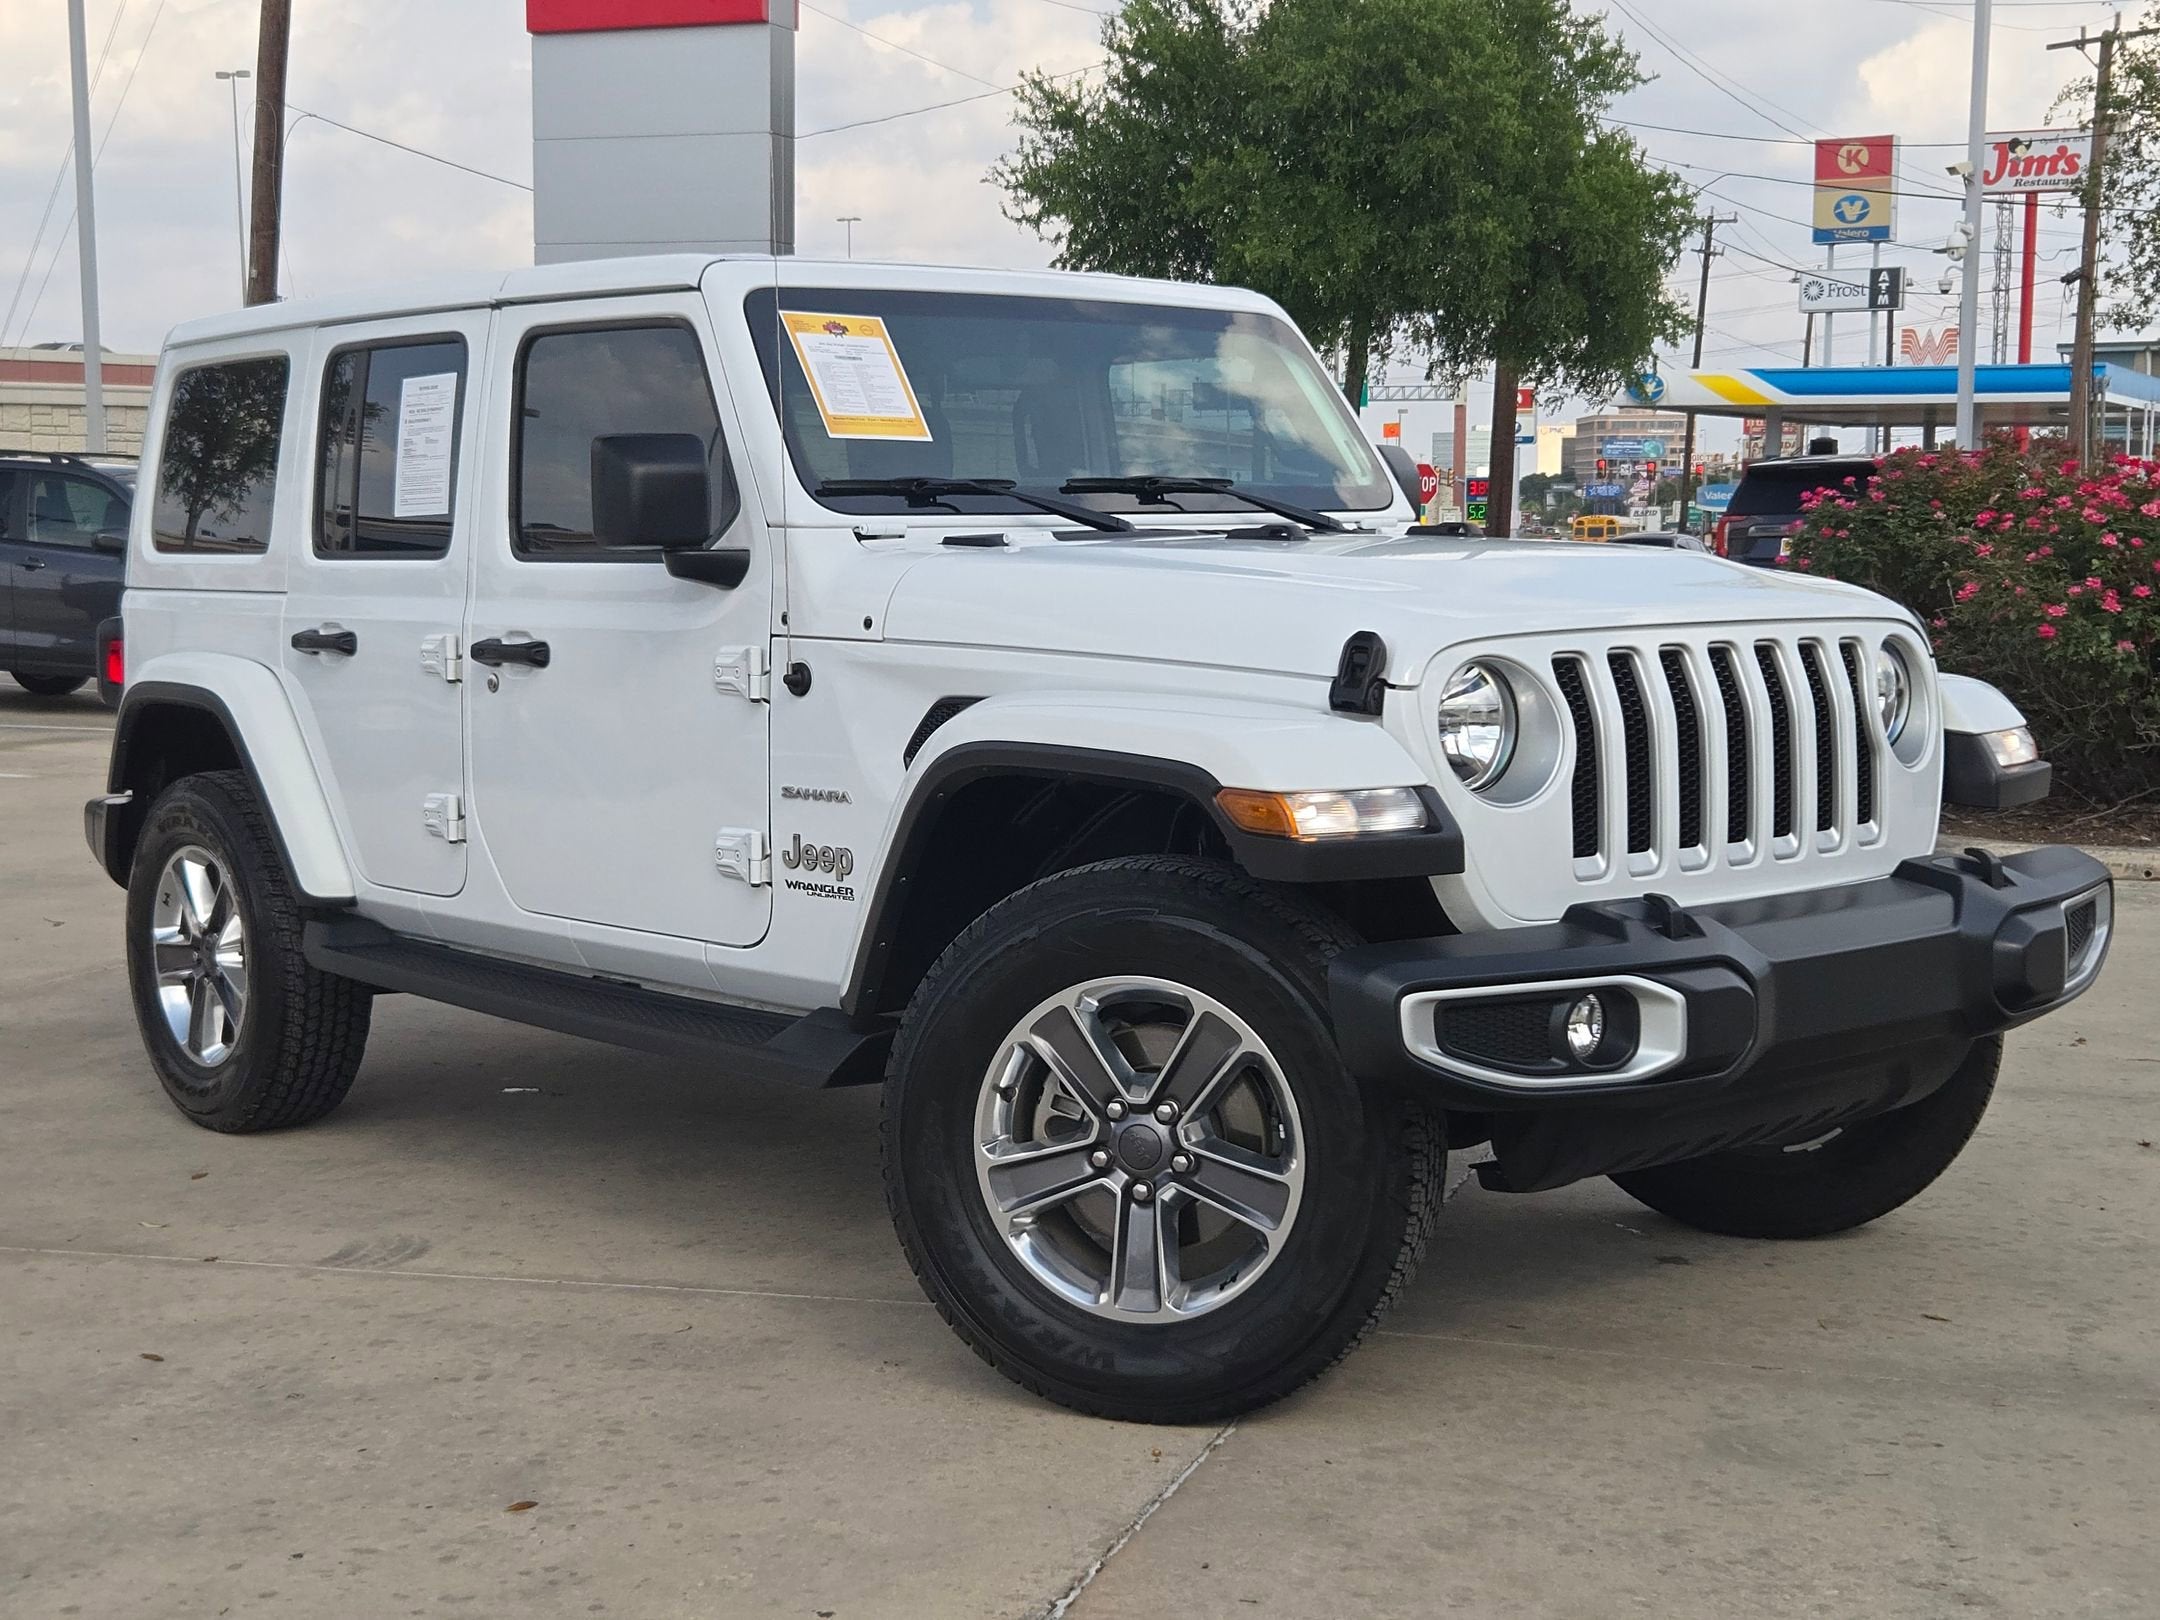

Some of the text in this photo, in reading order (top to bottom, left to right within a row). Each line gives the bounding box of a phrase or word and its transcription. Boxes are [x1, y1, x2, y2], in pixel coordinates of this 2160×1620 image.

[1983, 142, 2081, 186] Jim's
[1833, 228, 1869, 239] Valero
[1826, 283, 1867, 298] Frost
[1877, 270, 1889, 306] ATM
[1420, 477, 1437, 492] OP
[1704, 491, 1734, 500] Valer
[1469, 505, 1487, 519] 5.2
[781, 785, 852, 804] SAHARA
[782, 833, 854, 882] Jeep
[785, 879, 854, 897] WRANGLER
[807, 891, 855, 902] UNLIMITED
